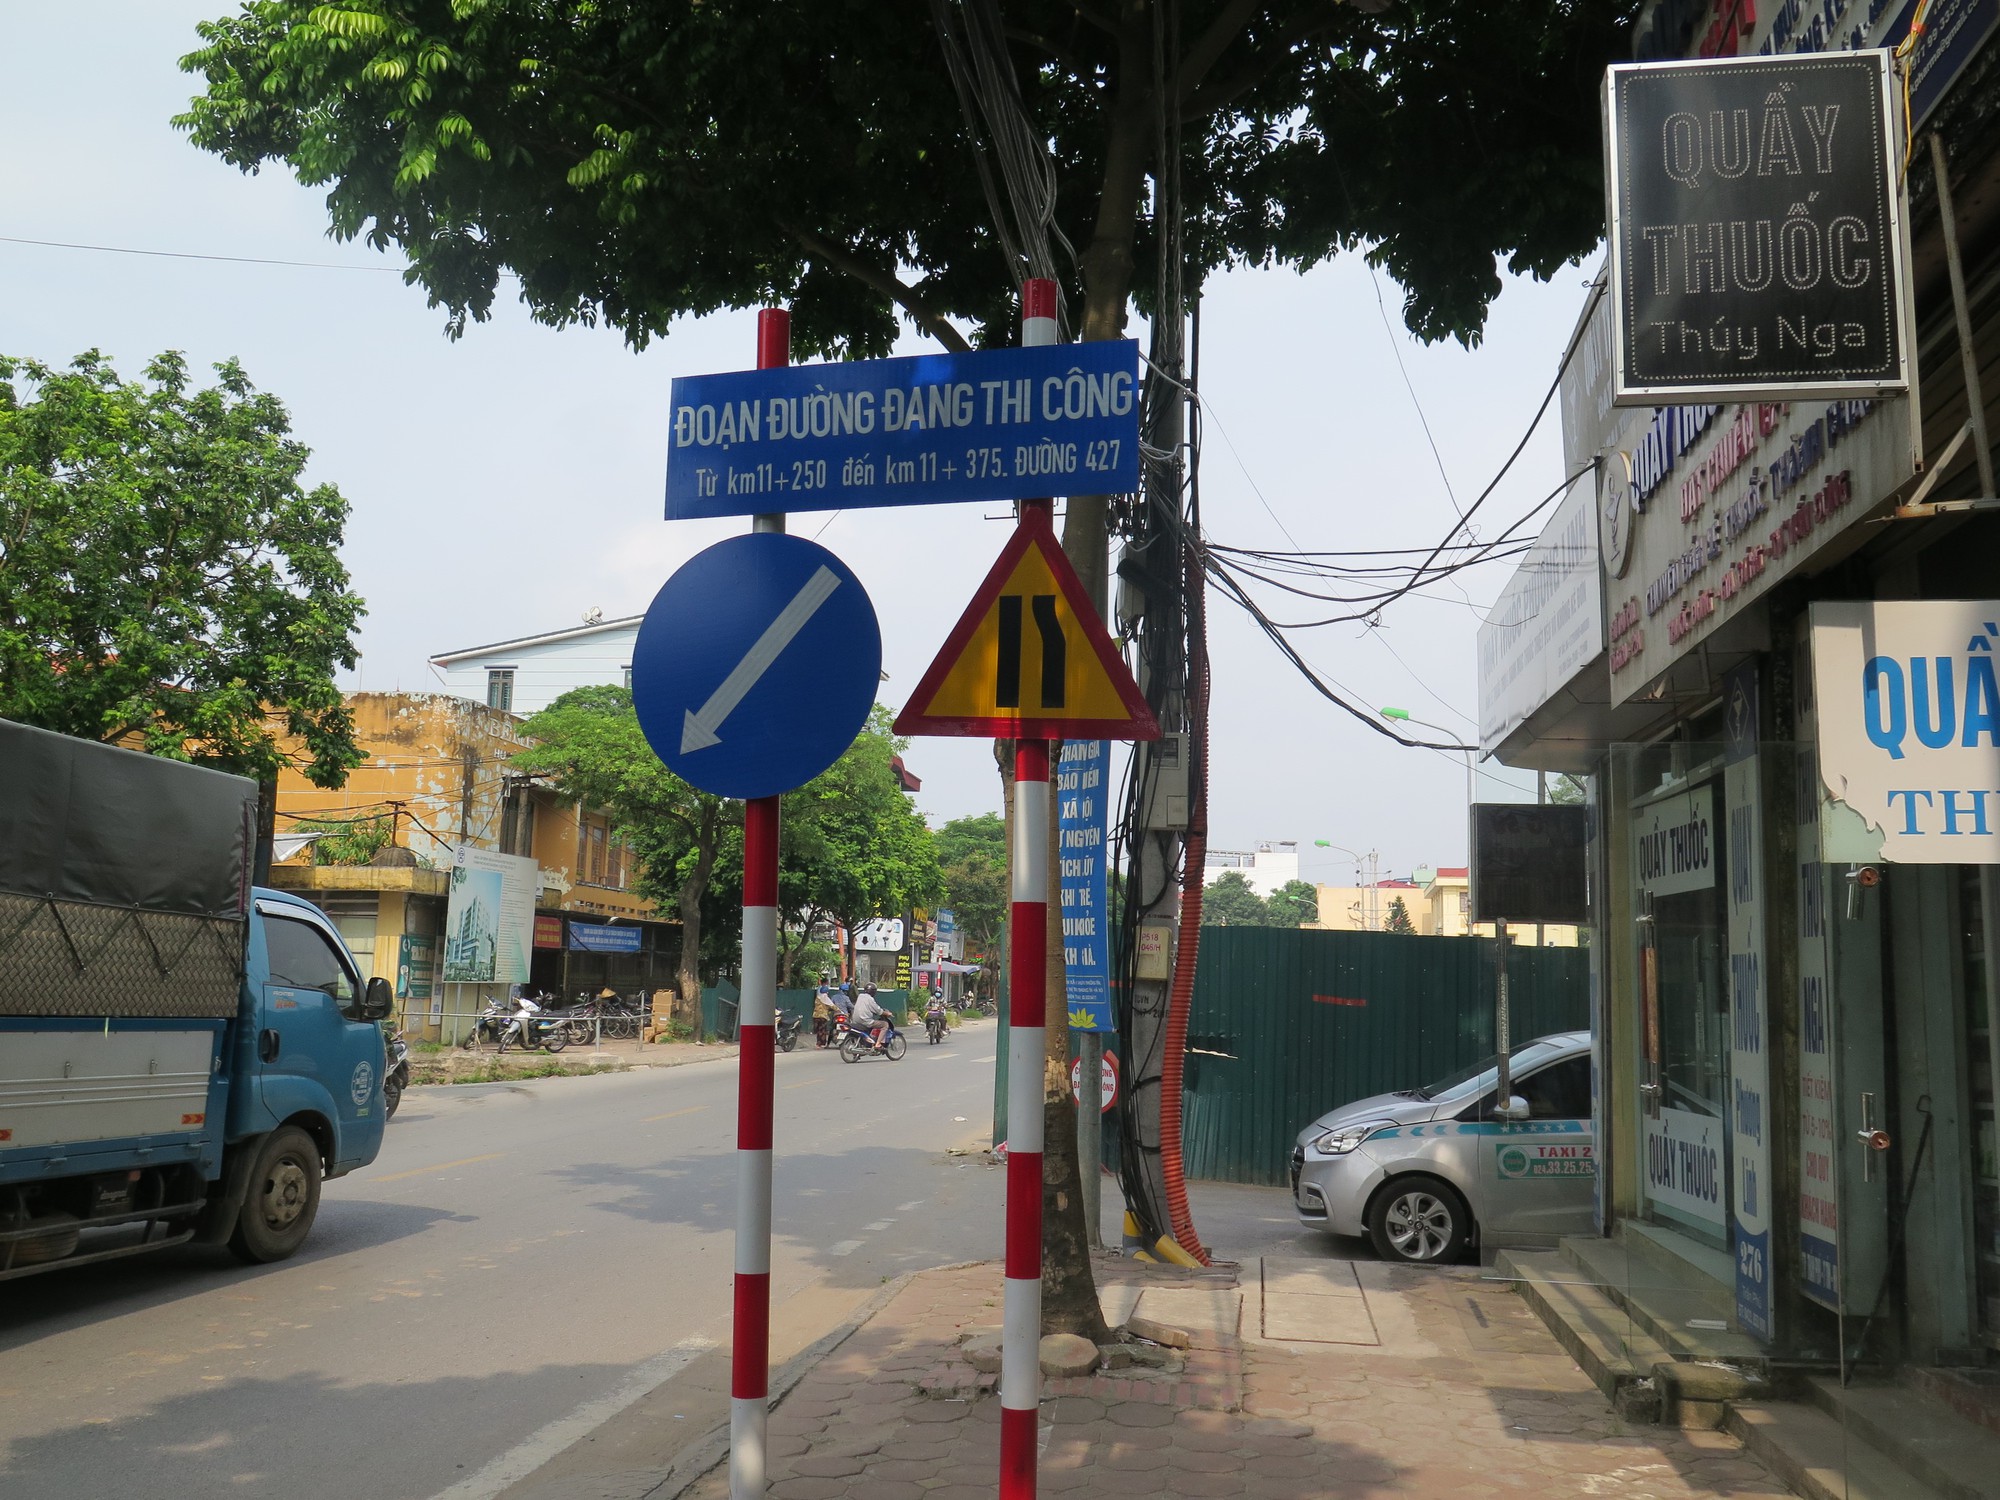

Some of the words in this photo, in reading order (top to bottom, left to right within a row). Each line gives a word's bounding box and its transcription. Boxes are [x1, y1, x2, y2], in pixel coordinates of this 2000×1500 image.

[1643, 191, 1871, 296] THUỐC
[1651, 316, 1759, 360] Thúy
[1778, 315, 1867, 358] Nga
[674, 399, 760, 451] ĐOẠN
[766, 384, 875, 441] ĐƯỜNG
[882, 383, 974, 432] ĐANG
[980, 378, 1031, 425] THI
[1042, 366, 1133, 422] CÔNG
[695, 468, 718, 497] Từ
[842, 452, 875, 487] đến
[966, 448, 1009, 479] 375.
[1014, 437, 1078, 477] ĐƯỜNG
[1085, 439, 1121, 471] 427
[1062, 797, 1078, 819] XÃ
[1887, 790, 2000, 835] TH
[1640, 816, 1667, 886] QUẦY
[1670, 802, 1709, 875] THUỐC
[1537, 1147, 1576, 1158] TAXI
[1649, 1119, 1676, 1189] QUẦY
[1679, 1127, 1718, 1204] THUỐC
[1740, 1240, 1763, 1284] 276
